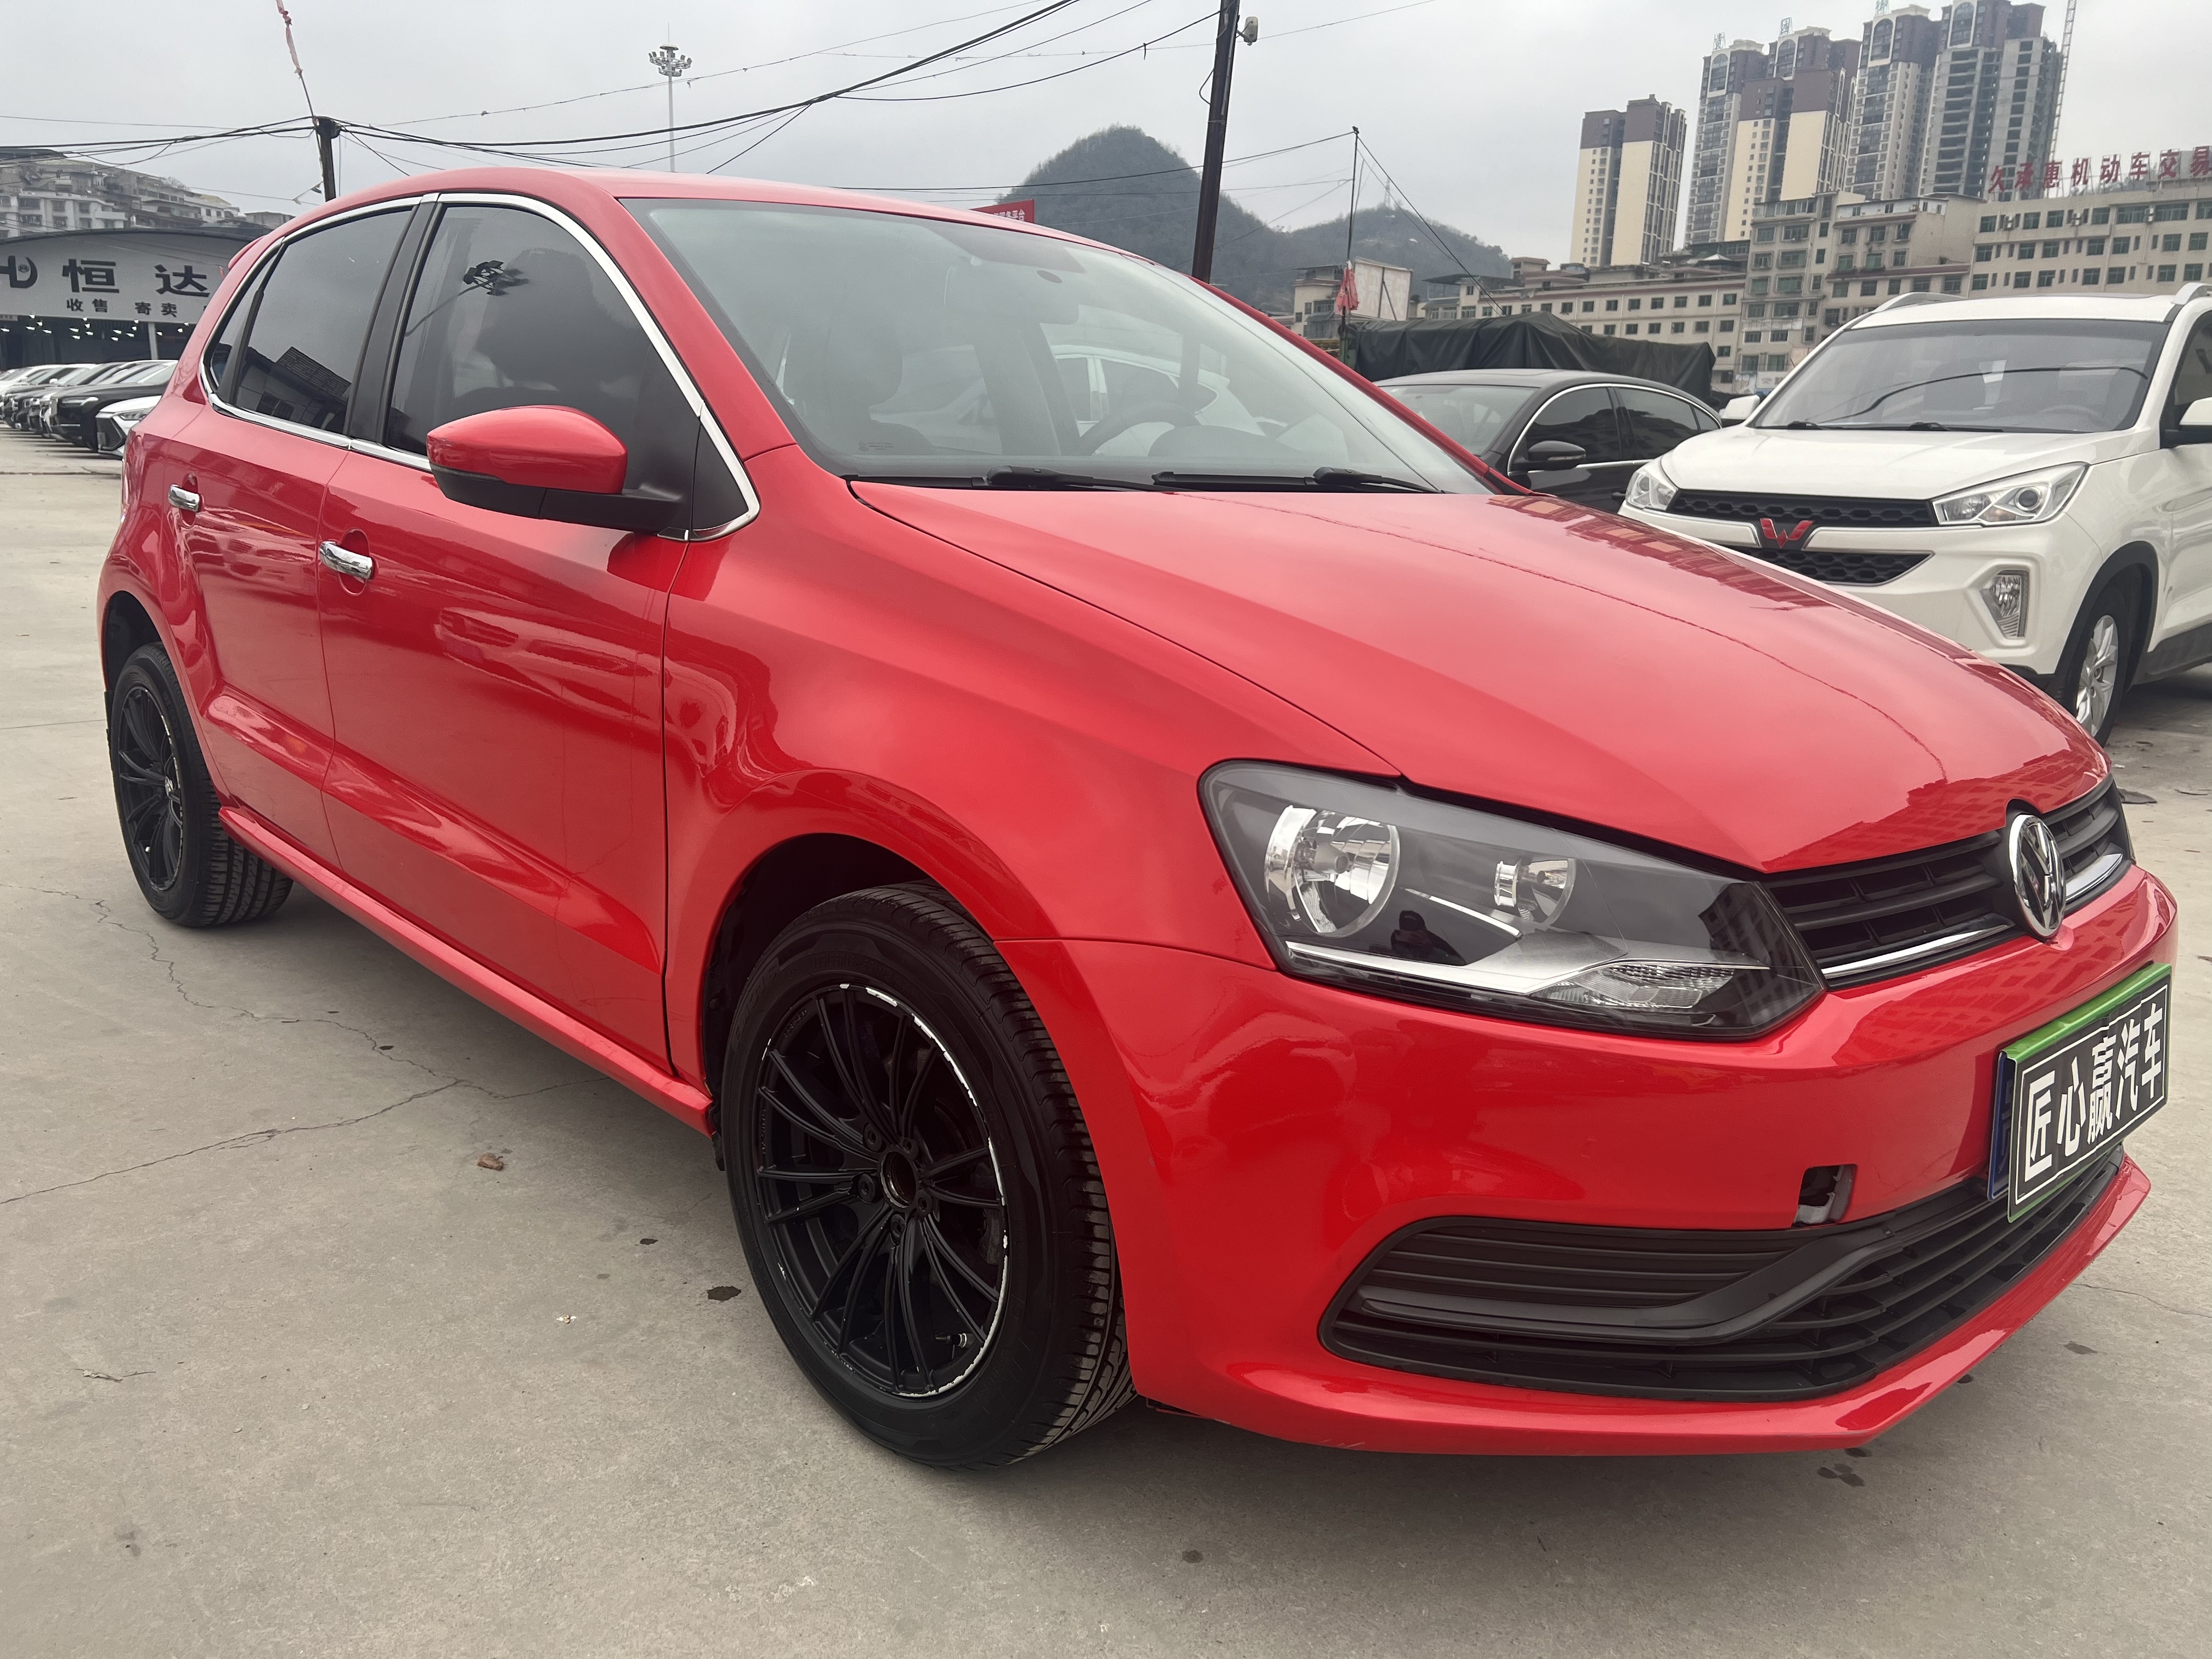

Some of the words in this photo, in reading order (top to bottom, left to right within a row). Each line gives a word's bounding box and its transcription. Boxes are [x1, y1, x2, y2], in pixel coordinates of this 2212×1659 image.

[62, 259, 210, 297] 恒达
[66, 298, 108, 313] 收售
[134, 302, 177, 317] 寄卖
[2025, 1003, 2163, 1182] 匠心赢汽车
